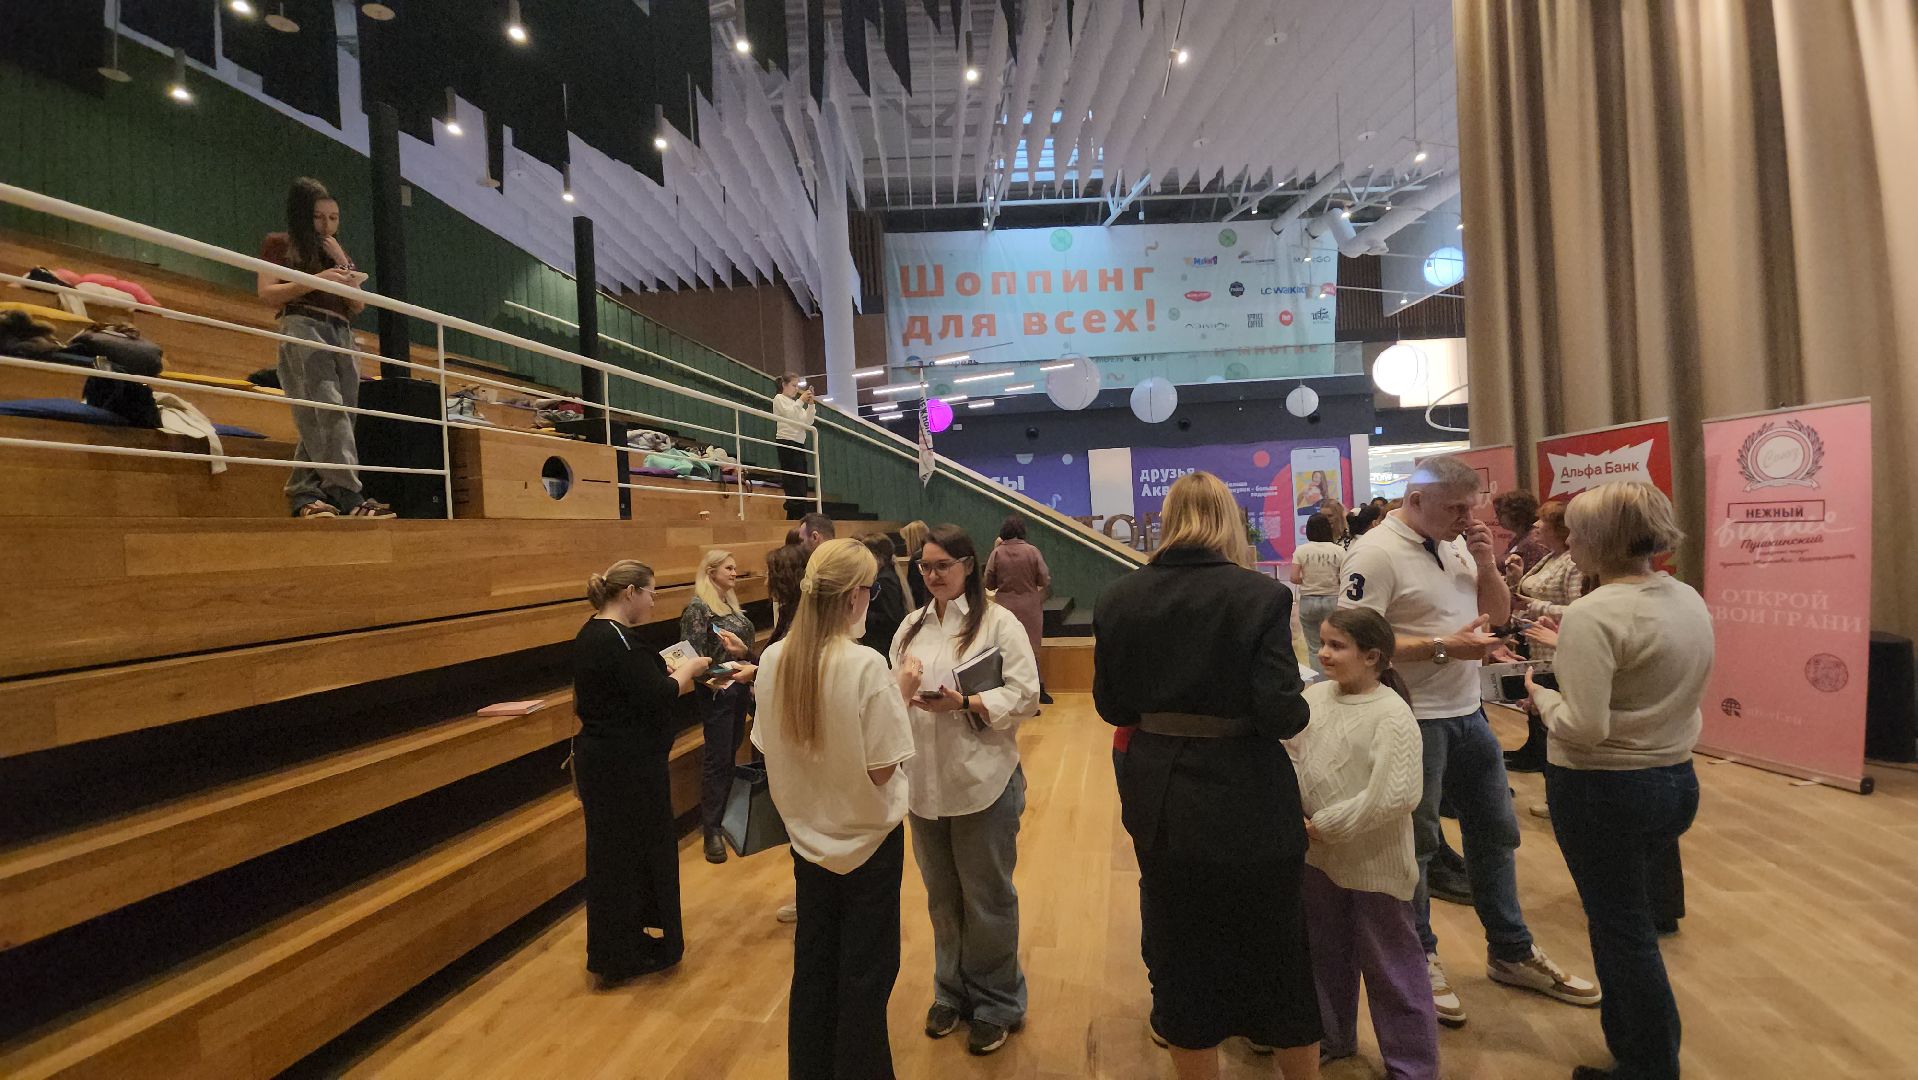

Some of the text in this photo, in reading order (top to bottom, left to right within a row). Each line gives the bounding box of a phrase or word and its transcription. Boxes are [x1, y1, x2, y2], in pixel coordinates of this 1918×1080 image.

[900, 264, 1154, 297] Шоппинг
[902, 298, 1156, 347] для всех!
[1560, 461, 1640, 479] Альфа Банк
[1746, 505, 1804, 519] НЕЖНЫЙ
[1346, 572, 1366, 601] 3
[1721, 589, 1829, 611] ОТКРОЙ
[1773, 610, 1862, 633] ГРАНИ
